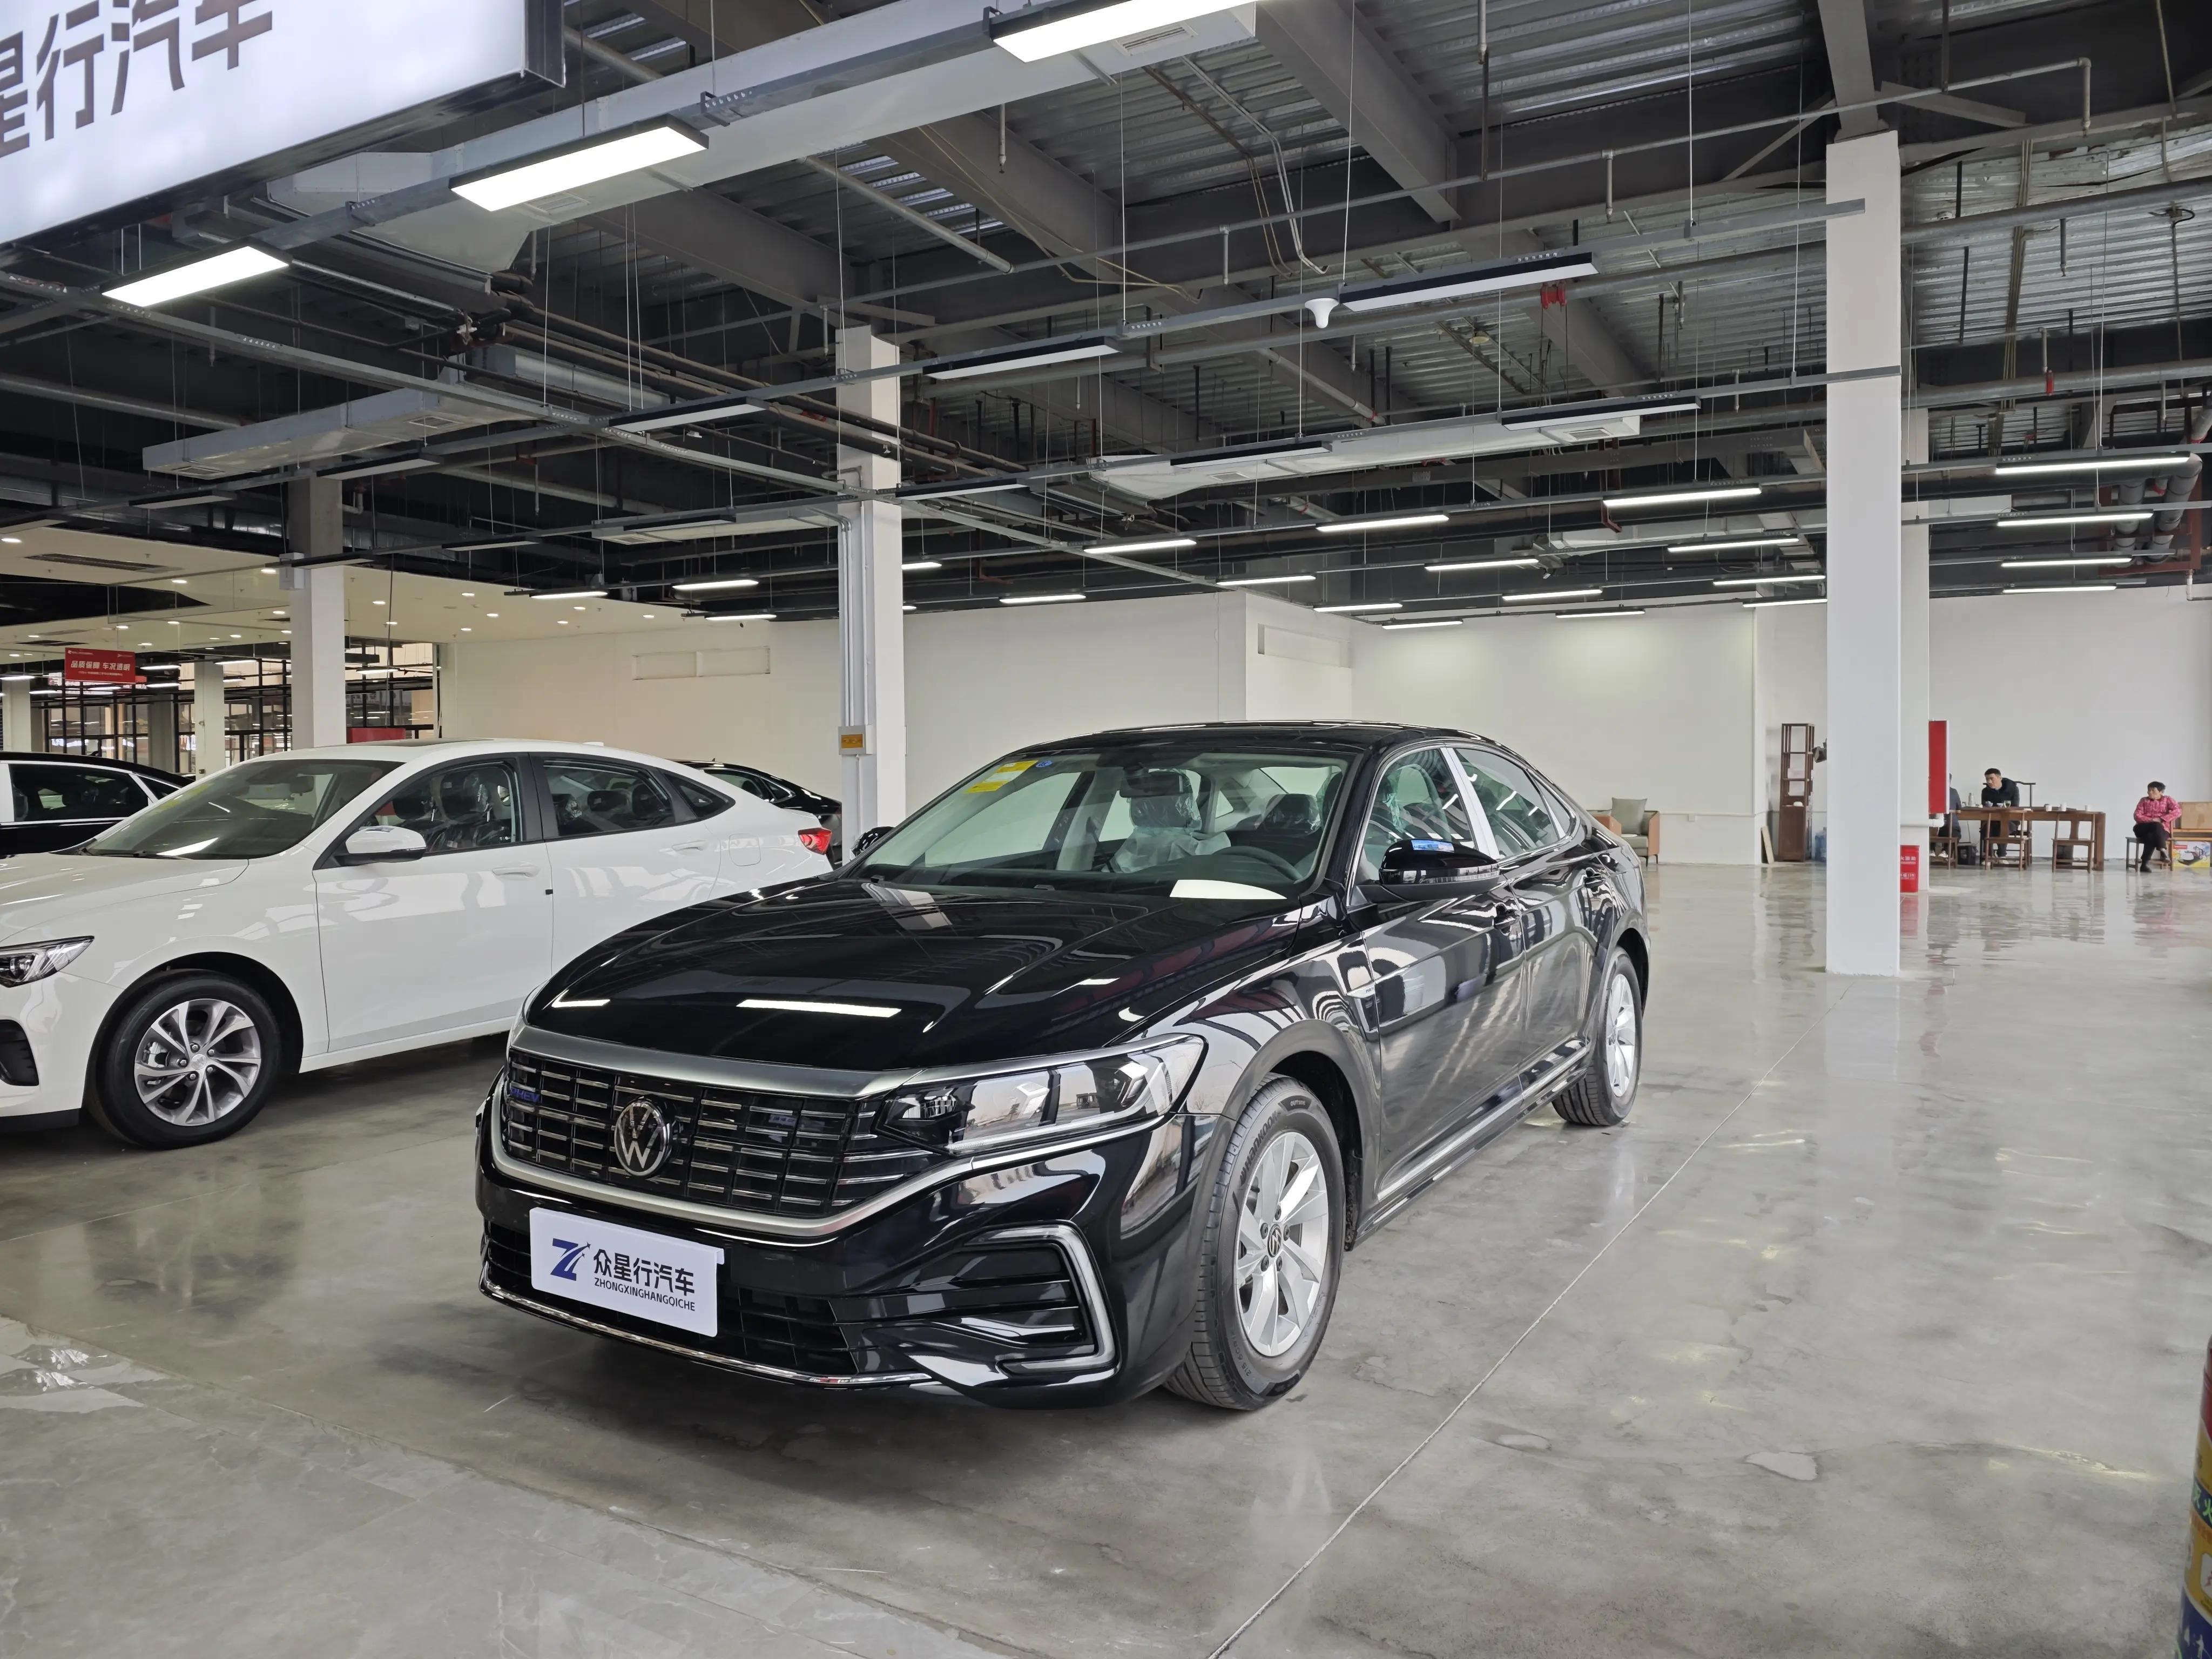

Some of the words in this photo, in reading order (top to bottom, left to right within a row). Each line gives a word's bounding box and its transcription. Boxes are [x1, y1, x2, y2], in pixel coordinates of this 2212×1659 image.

[103, 662, 130, 671] 车况透明
[594, 1249, 695, 1296] 众星行汽车
[595, 1277, 696, 1312] ZHONGXINGHANGQICHE
